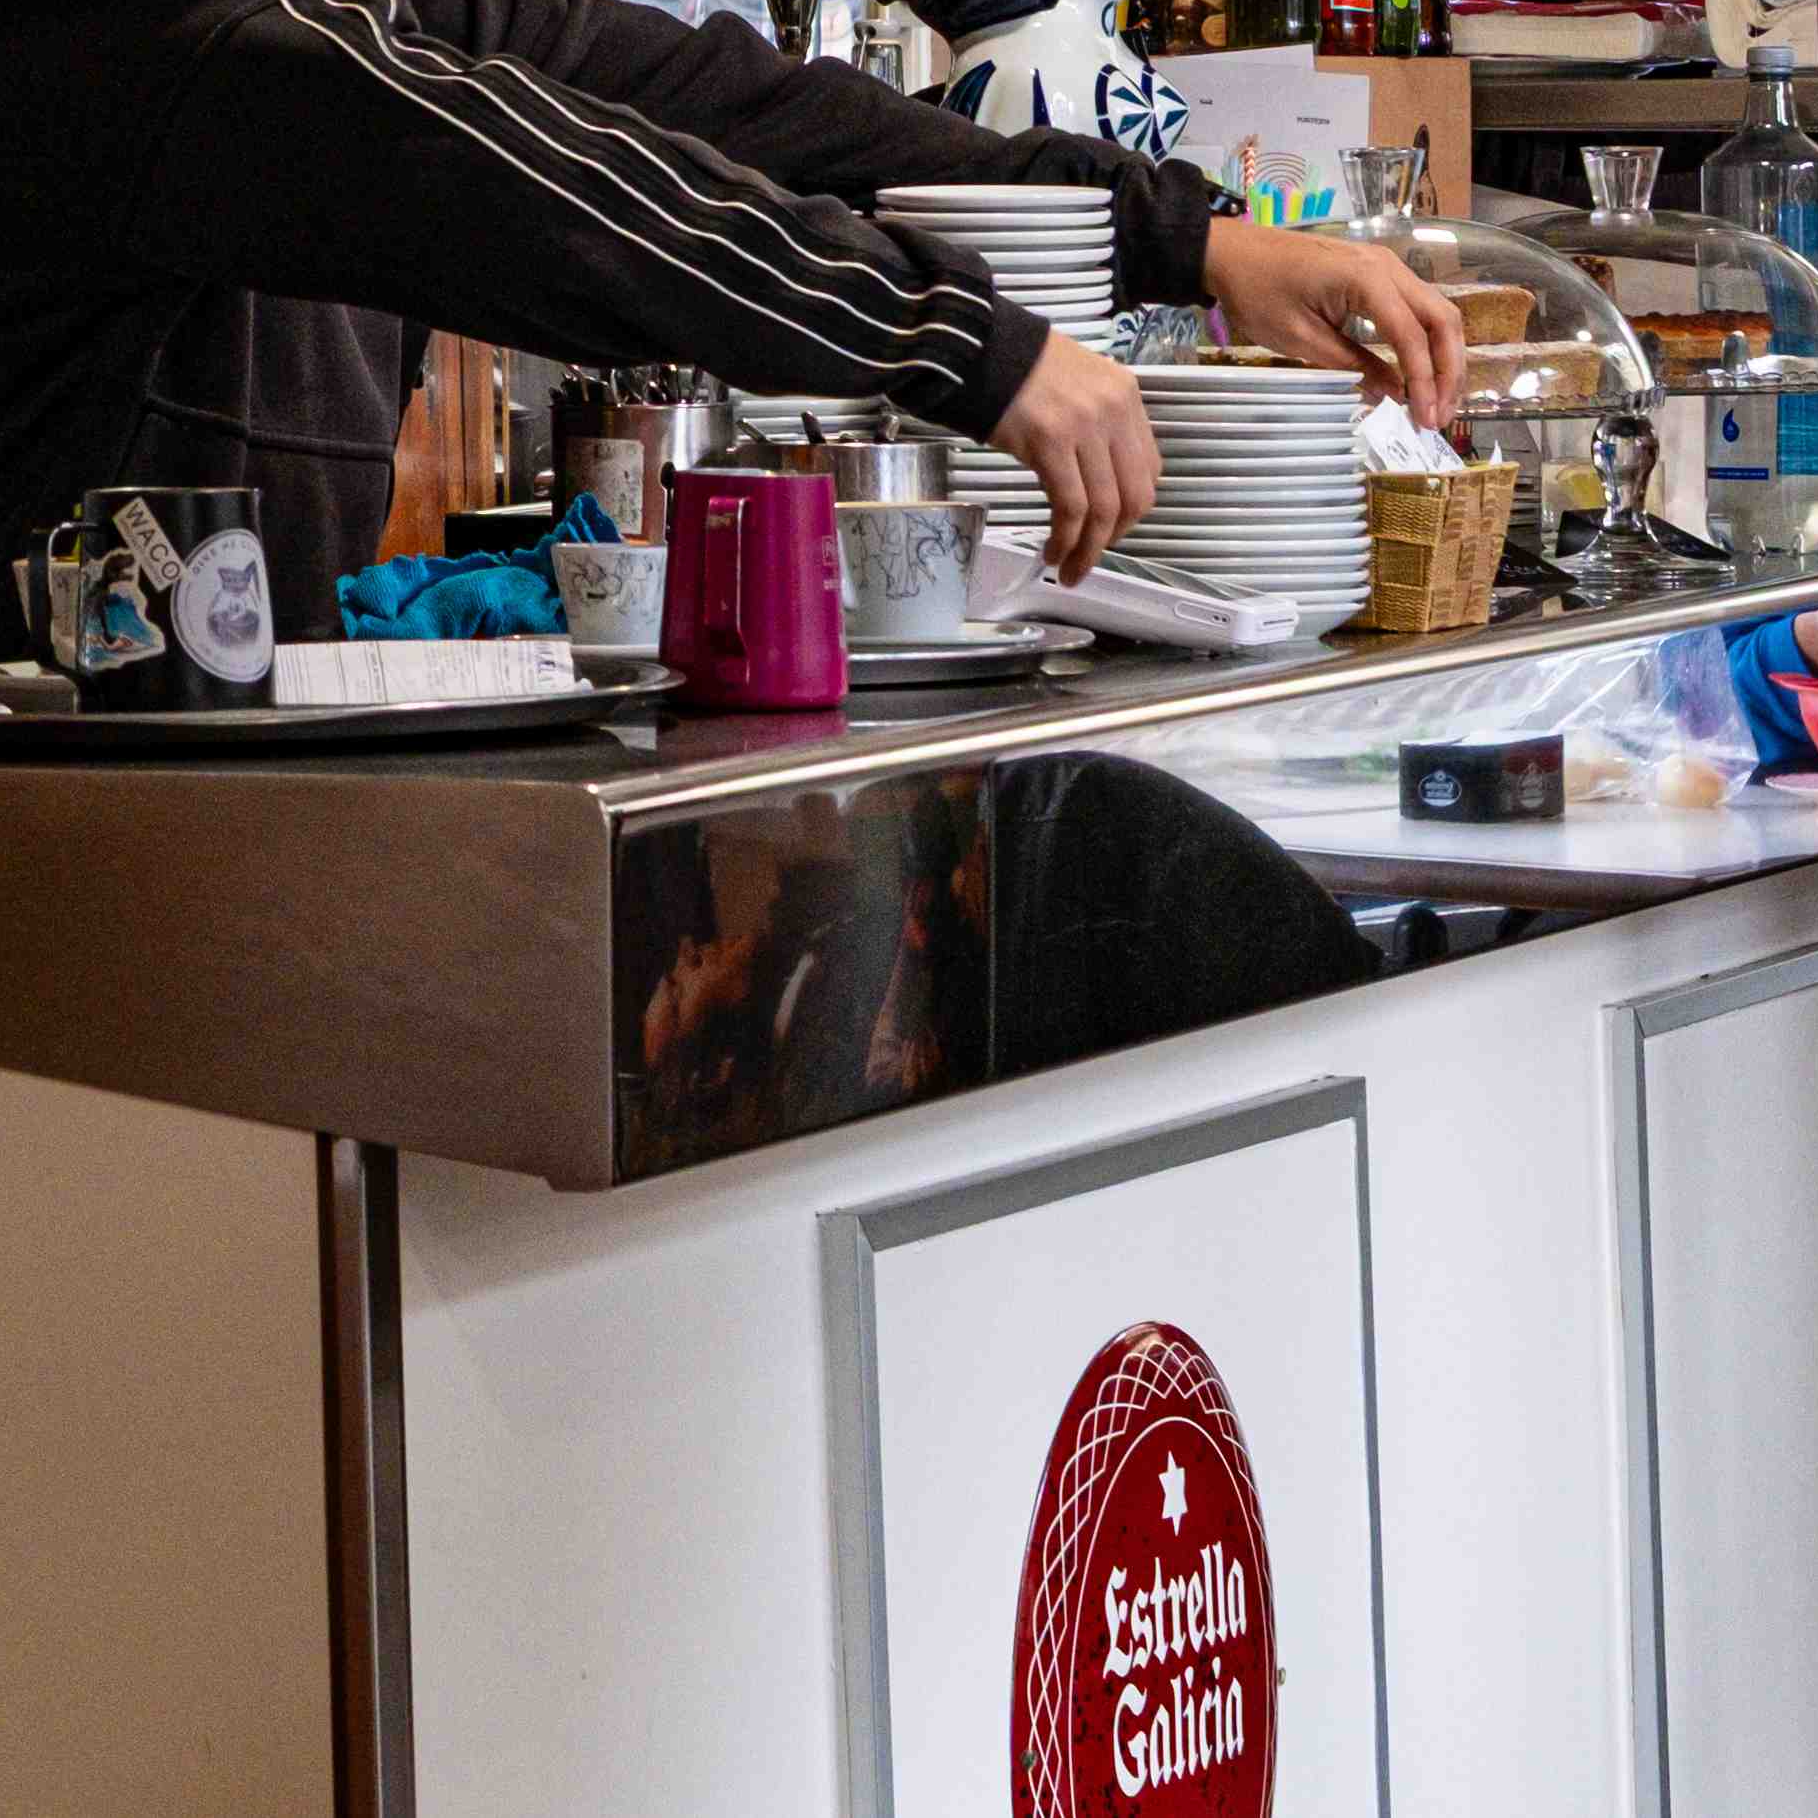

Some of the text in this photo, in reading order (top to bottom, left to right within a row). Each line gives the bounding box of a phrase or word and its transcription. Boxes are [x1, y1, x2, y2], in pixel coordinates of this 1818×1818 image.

[125, 503, 180, 581] WACO
[1102, 1541, 1247, 1680] Estrella
[1112, 1656, 1245, 1798] Galicia
